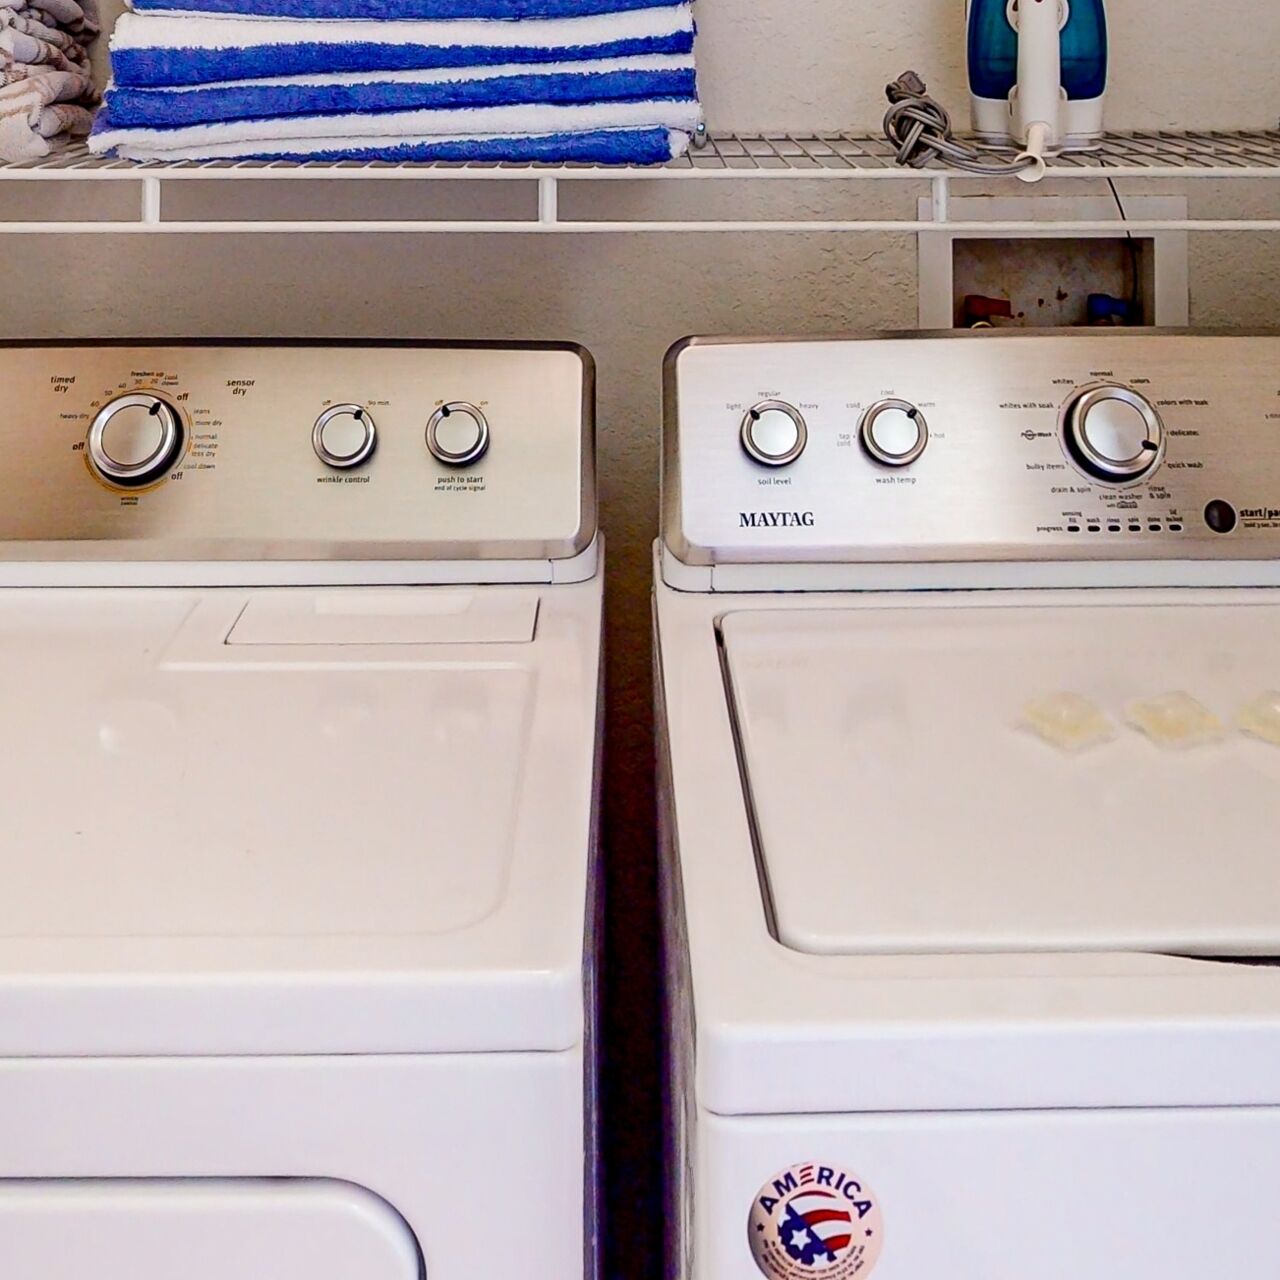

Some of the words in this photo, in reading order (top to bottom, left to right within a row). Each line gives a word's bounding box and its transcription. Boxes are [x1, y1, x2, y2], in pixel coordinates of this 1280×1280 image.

[50, 375, 76, 384] timed
[54, 384, 68, 393] dry
[232, 387, 247, 396] dry
[176, 393, 189, 401] off
[72, 442, 85, 450] off
[171, 472, 183, 480] off
[437, 476, 455, 485] push
[897, 477, 917, 485] temp
[739, 512, 815, 527] MAYTAG
[759, 1165, 873, 1219] AMERICA
